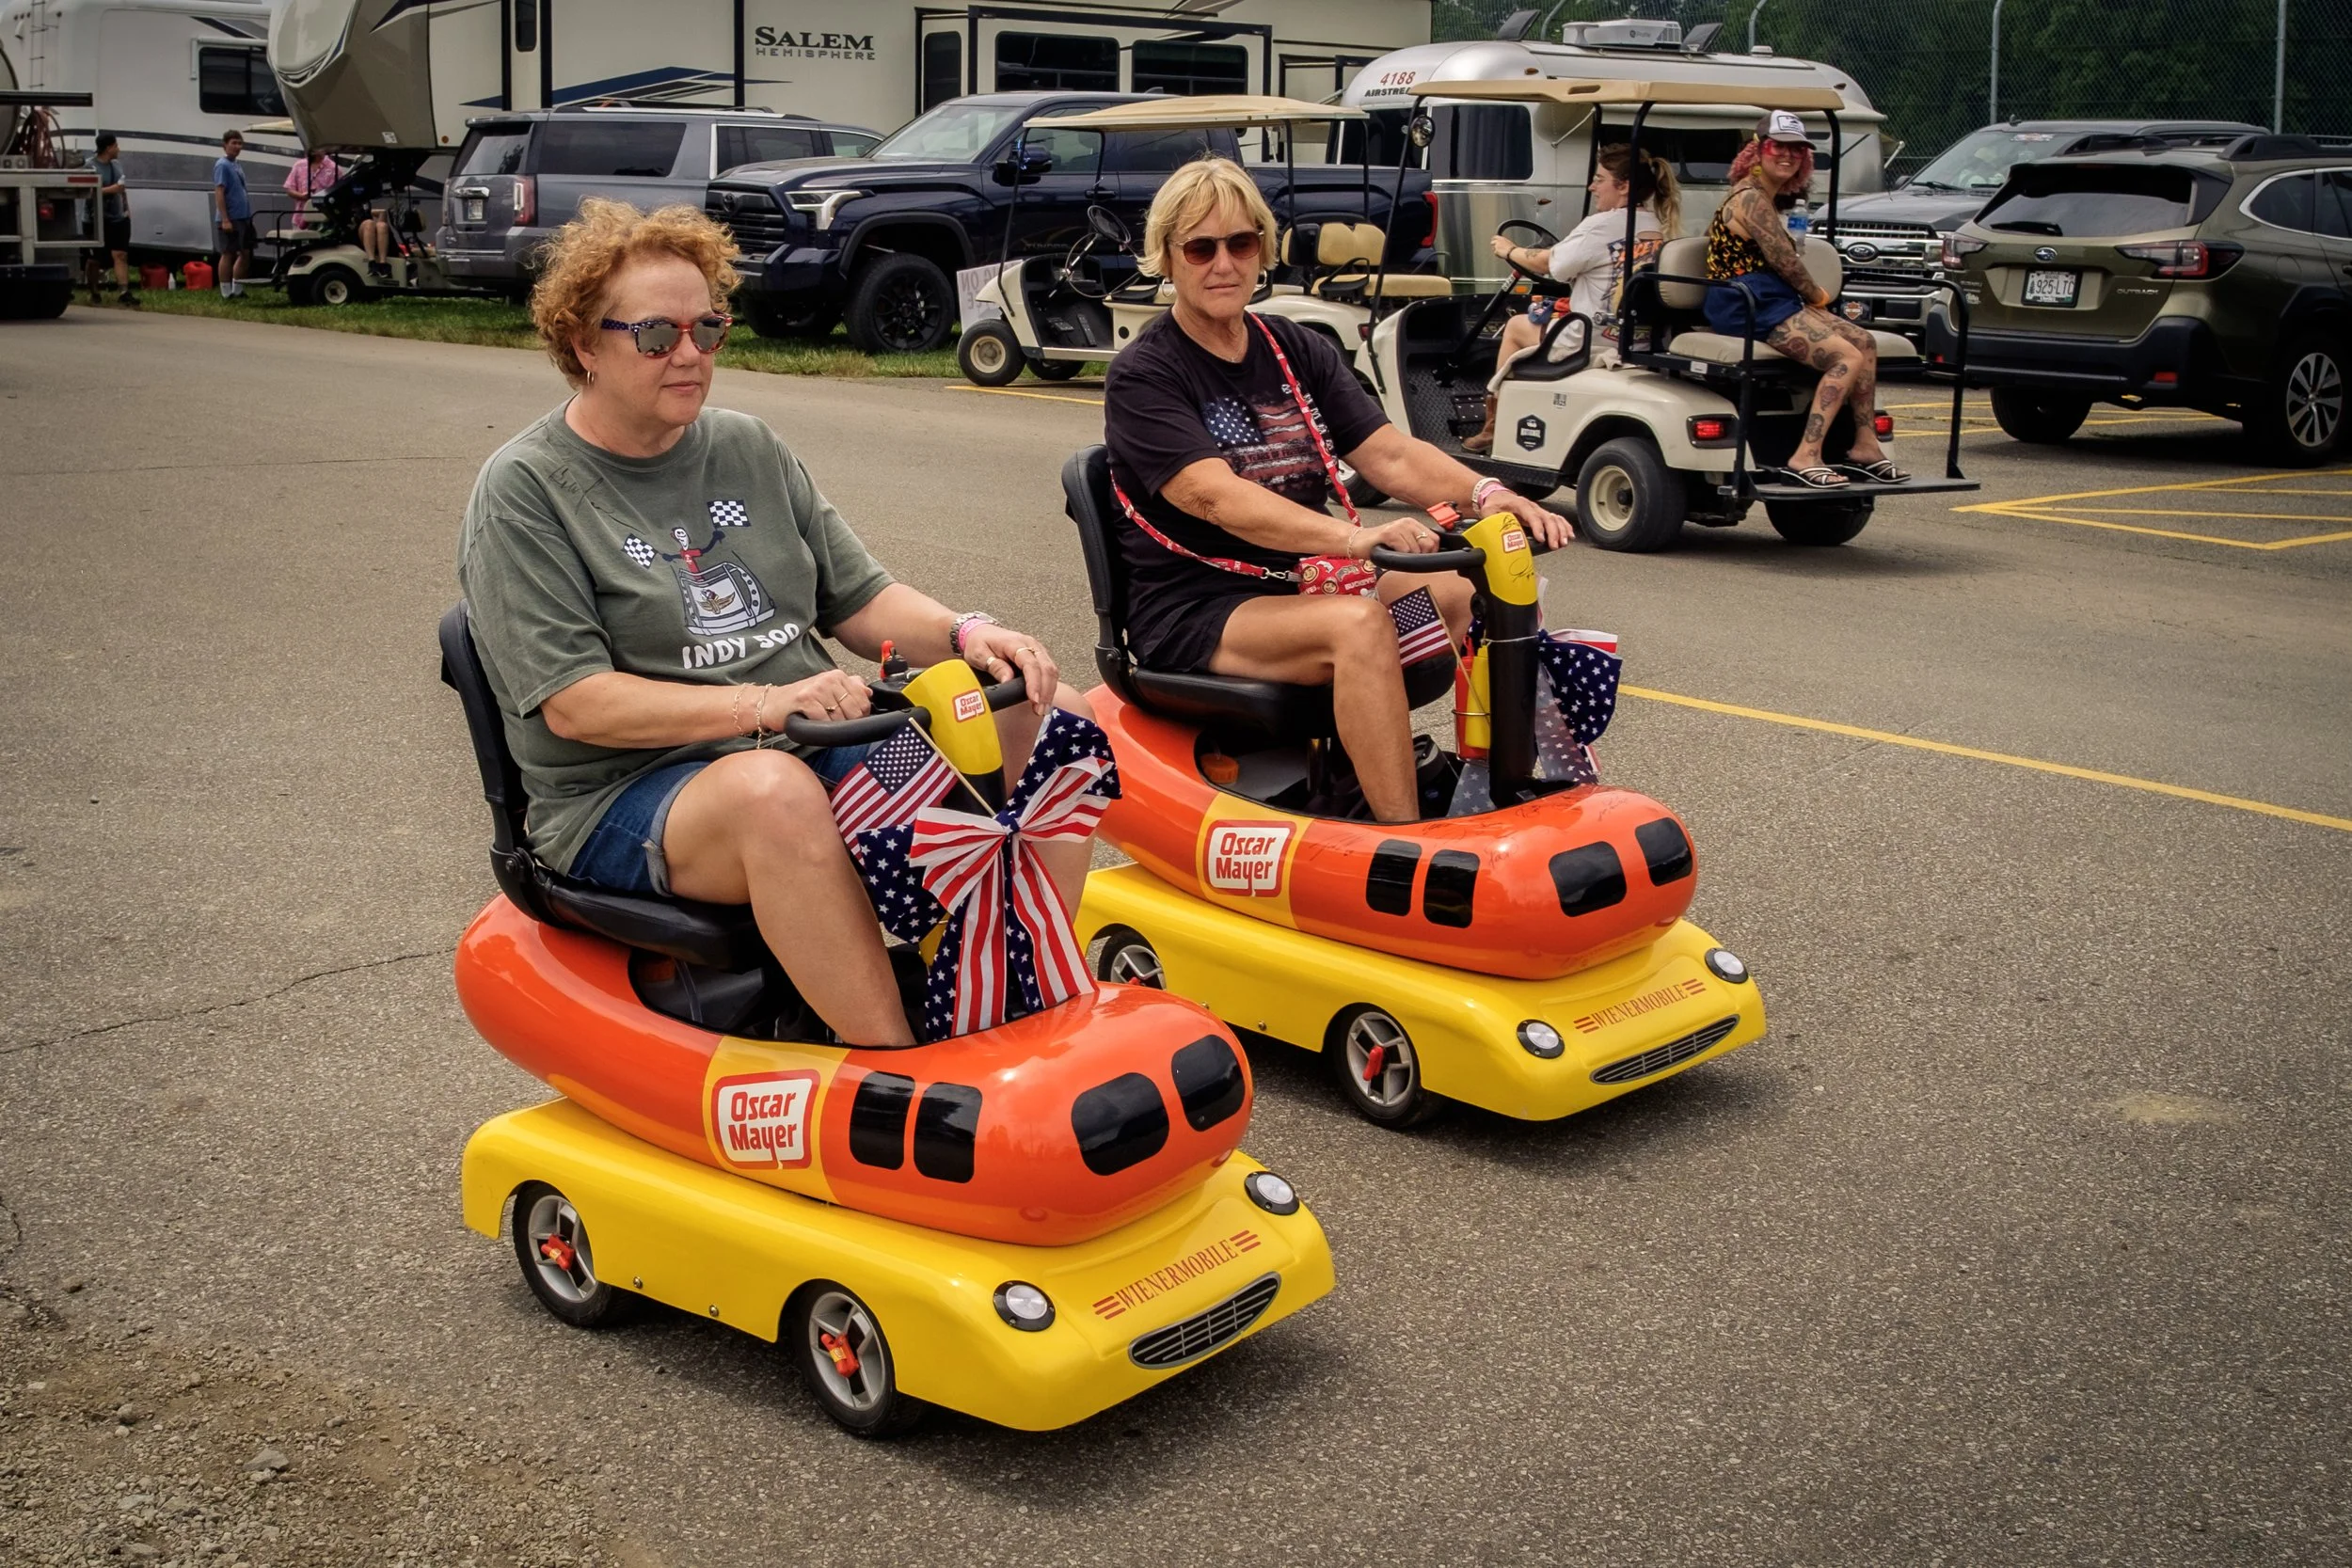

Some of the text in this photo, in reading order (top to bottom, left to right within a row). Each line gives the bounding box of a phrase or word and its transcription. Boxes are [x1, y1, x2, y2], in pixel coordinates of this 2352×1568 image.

[755, 26, 874, 50] SALEM
[755, 47, 876, 60] HEMISPHERE
[1380, 71, 1416, 86] 4188
[682, 623, 800, 670] INDY 500
[960, 695, 978, 707] Oscar
[961, 702, 982, 716] Mayer
[1220, 832, 1277, 856] Oscar
[1216, 857, 1273, 891] Mayer
[1591, 984, 1689, 1029] WIENERMOBILE
[730, 1091, 797, 1122] Oscar
[728, 1122, 798, 1163] Mayer
[1114, 1239, 1239, 1310] WIENERMOBILE
